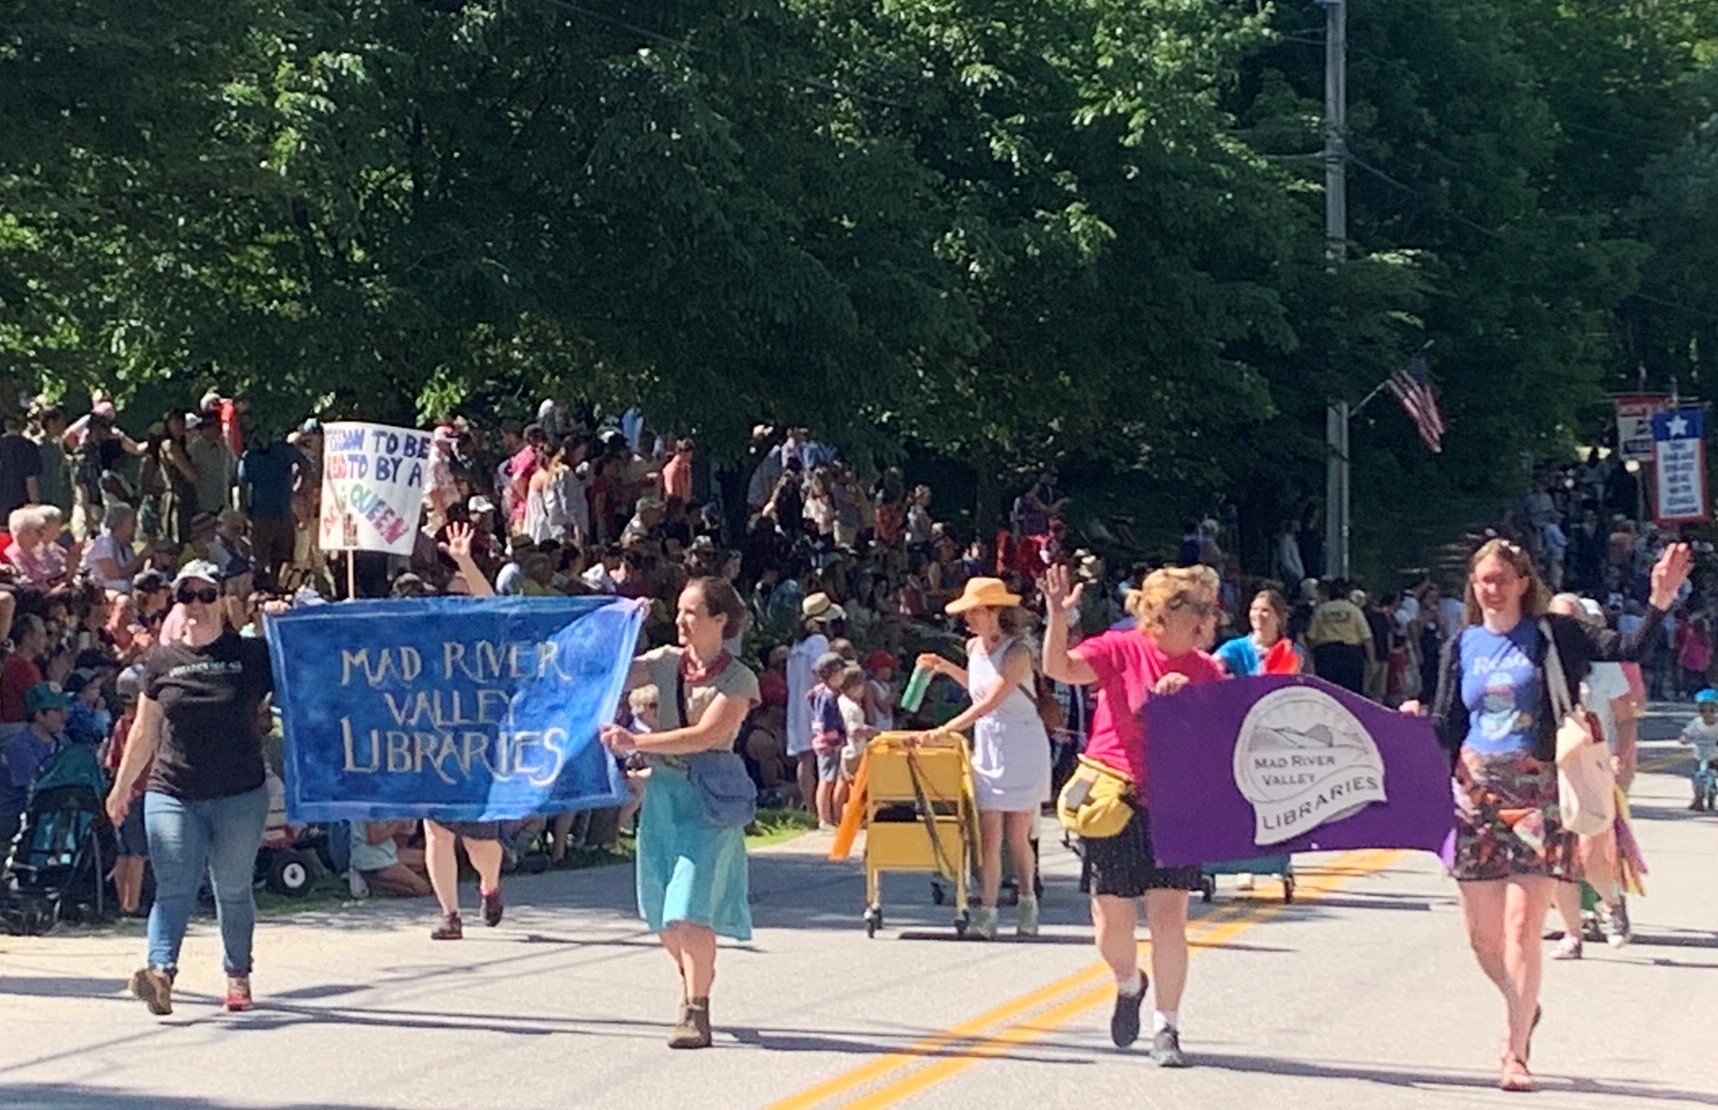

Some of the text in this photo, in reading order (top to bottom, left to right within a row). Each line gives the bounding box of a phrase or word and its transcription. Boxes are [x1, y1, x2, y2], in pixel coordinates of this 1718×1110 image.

[372, 431, 399, 455] TO
[403, 434, 431, 459] BE
[348, 454, 368, 479] TO
[375, 457, 402, 482] BY
[407, 462, 422, 488] A
[350, 483, 410, 545] QUEEN
[340, 639, 573, 688] MAD RIVER
[384, 689, 526, 727] VALLEY
[340, 716, 569, 786] LIBRARIES
[1254, 754, 1336, 769] MAD RIVER
[1261, 774, 1316, 787] VALLEY
[1262, 776, 1380, 830] LIBRARIES
